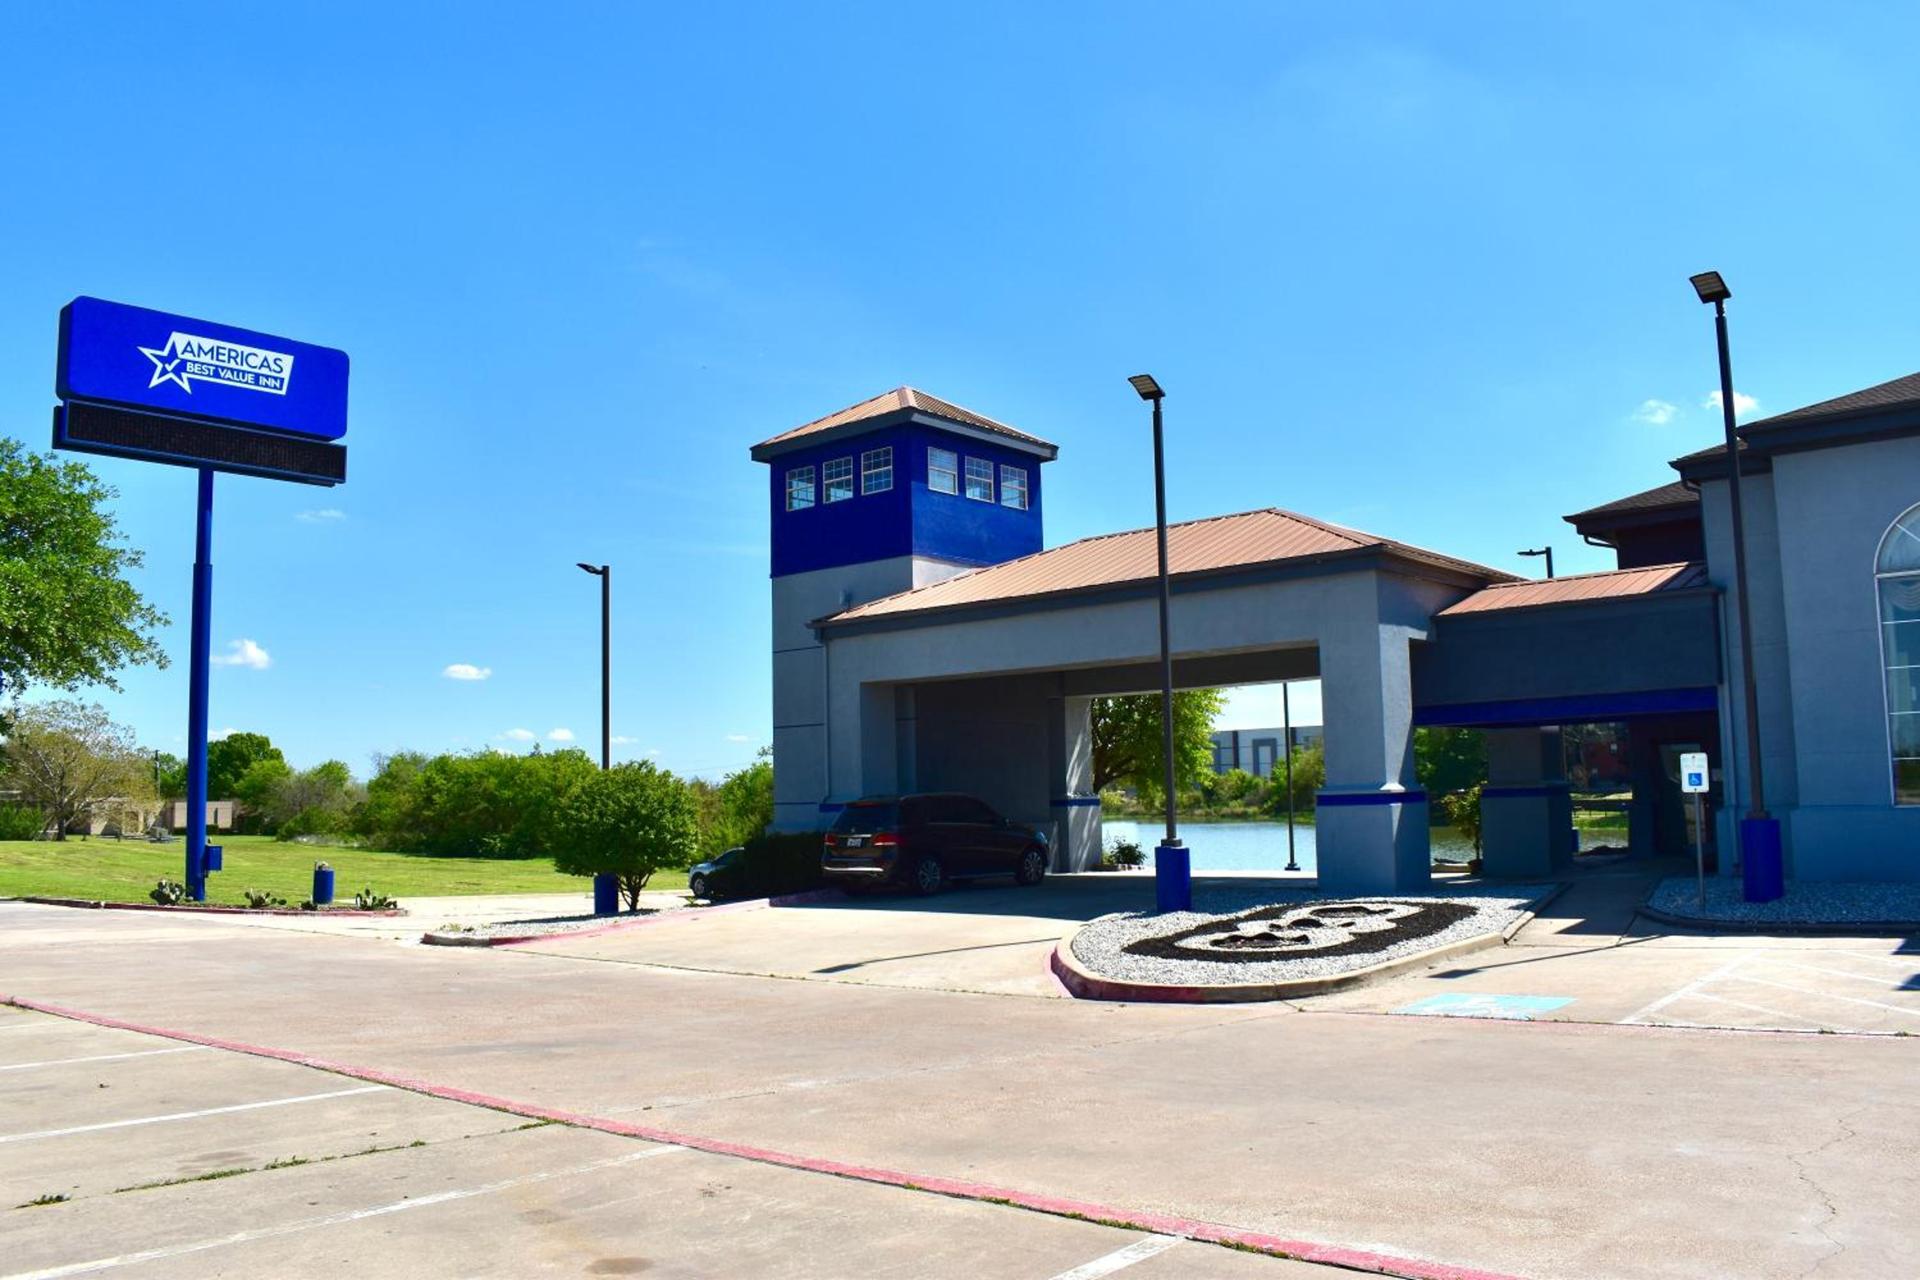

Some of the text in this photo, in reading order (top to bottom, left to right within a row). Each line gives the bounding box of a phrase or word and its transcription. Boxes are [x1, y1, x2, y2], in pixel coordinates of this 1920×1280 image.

[180, 340, 284, 374] AMERICAS
[186, 361, 281, 389] BEST VALUE INN
